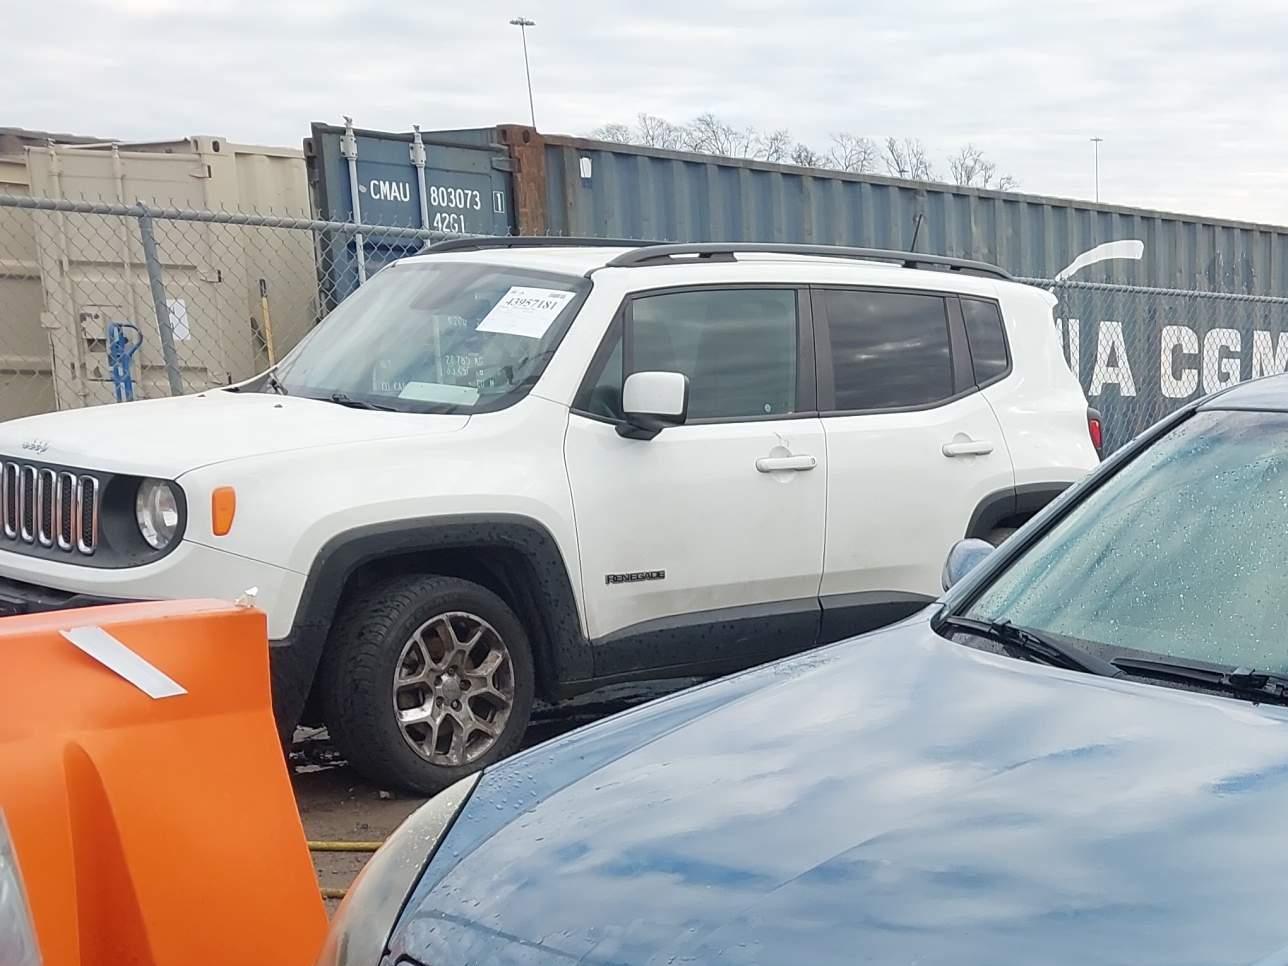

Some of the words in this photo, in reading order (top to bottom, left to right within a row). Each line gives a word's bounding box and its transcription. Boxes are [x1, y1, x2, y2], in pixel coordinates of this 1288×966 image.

[370, 179, 410, 202] CMAU
[430, 186, 481, 210] 803073
[433, 213, 466, 233] 42G1
[604, 570, 666, 584] RENEGADE
